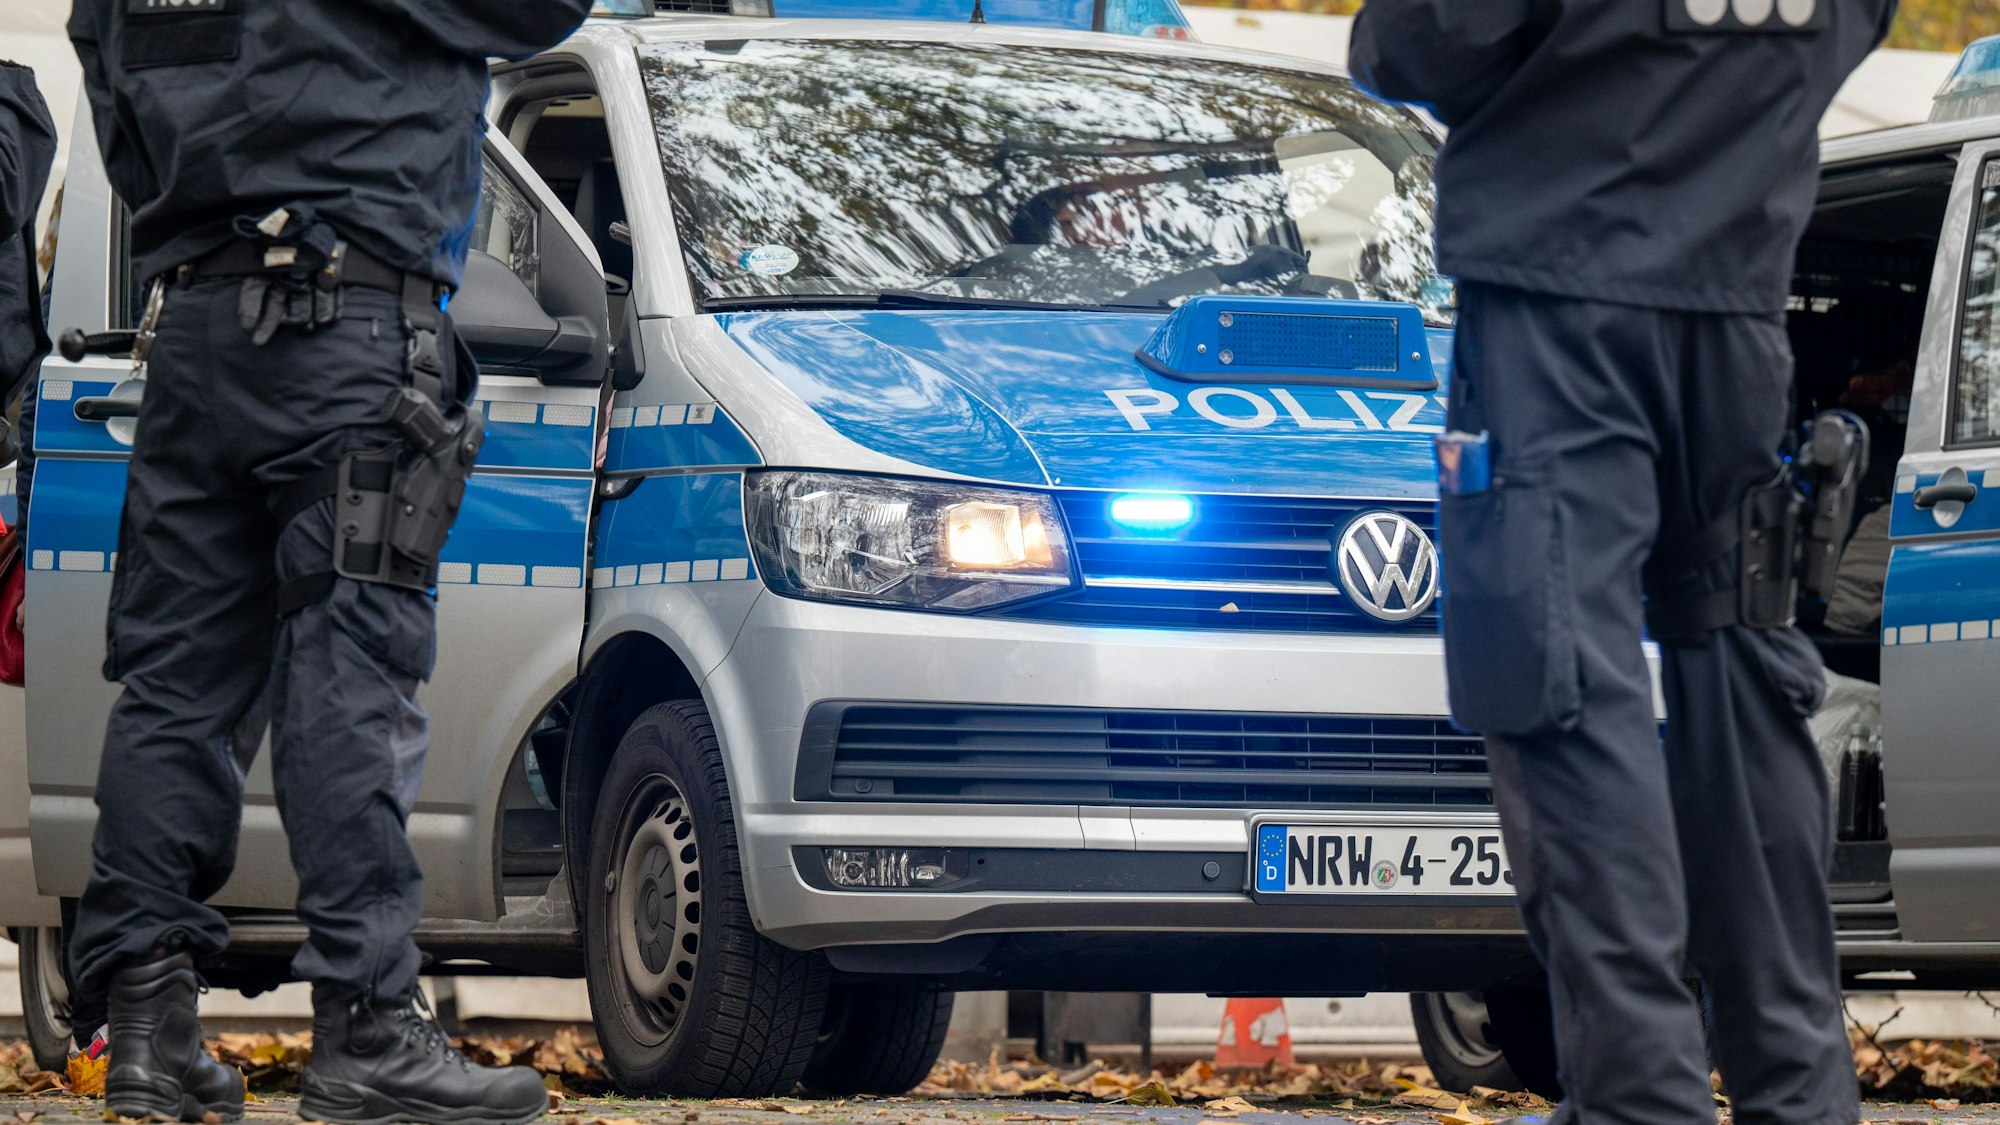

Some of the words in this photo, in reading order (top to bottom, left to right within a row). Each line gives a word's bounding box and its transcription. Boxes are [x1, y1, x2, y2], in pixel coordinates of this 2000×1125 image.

[1103, 387, 1447, 433] POLIZ
[1338, 512, 1439, 621] VW
[1266, 866, 1278, 881] D
[1288, 835, 1373, 886] NRW
[1400, 835, 1517, 886] 4-25
